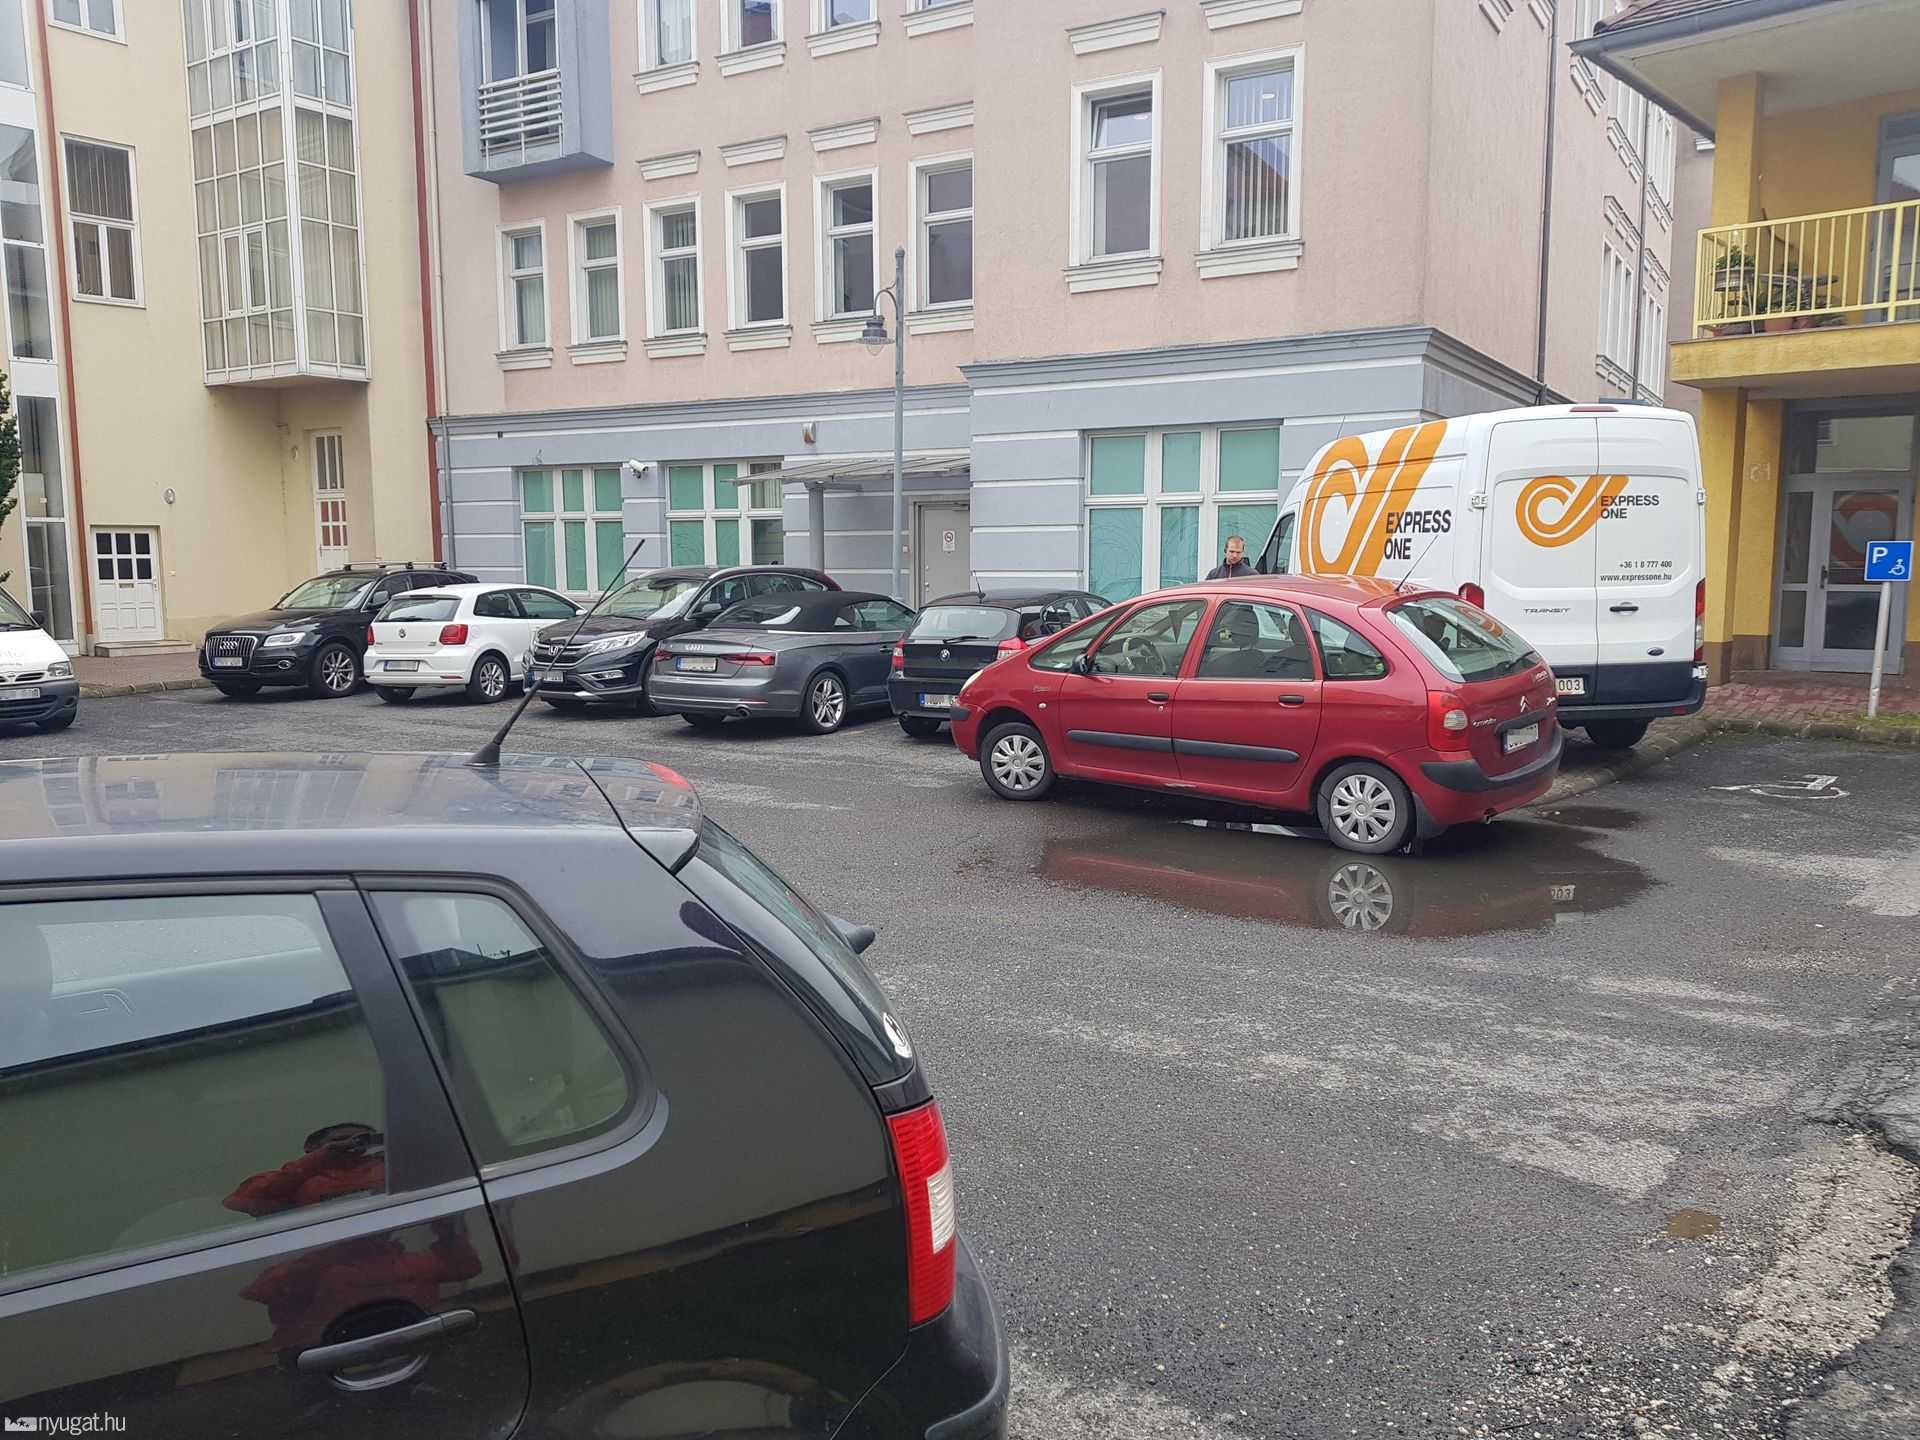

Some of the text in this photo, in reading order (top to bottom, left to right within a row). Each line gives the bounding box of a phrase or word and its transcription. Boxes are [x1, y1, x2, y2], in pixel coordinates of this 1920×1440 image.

[1600, 494, 1660, 507] EXPRESS
[1600, 507, 1628, 519] ONE
[1385, 509, 1452, 534] EXPRESS
[1384, 537, 1412, 560] ONE
[1872, 546, 1889, 564] P
[1646, 560, 1659, 568] 777
[1600, 572, 1672, 582] www.expressone.hu
[1558, 679, 1581, 691] 003
